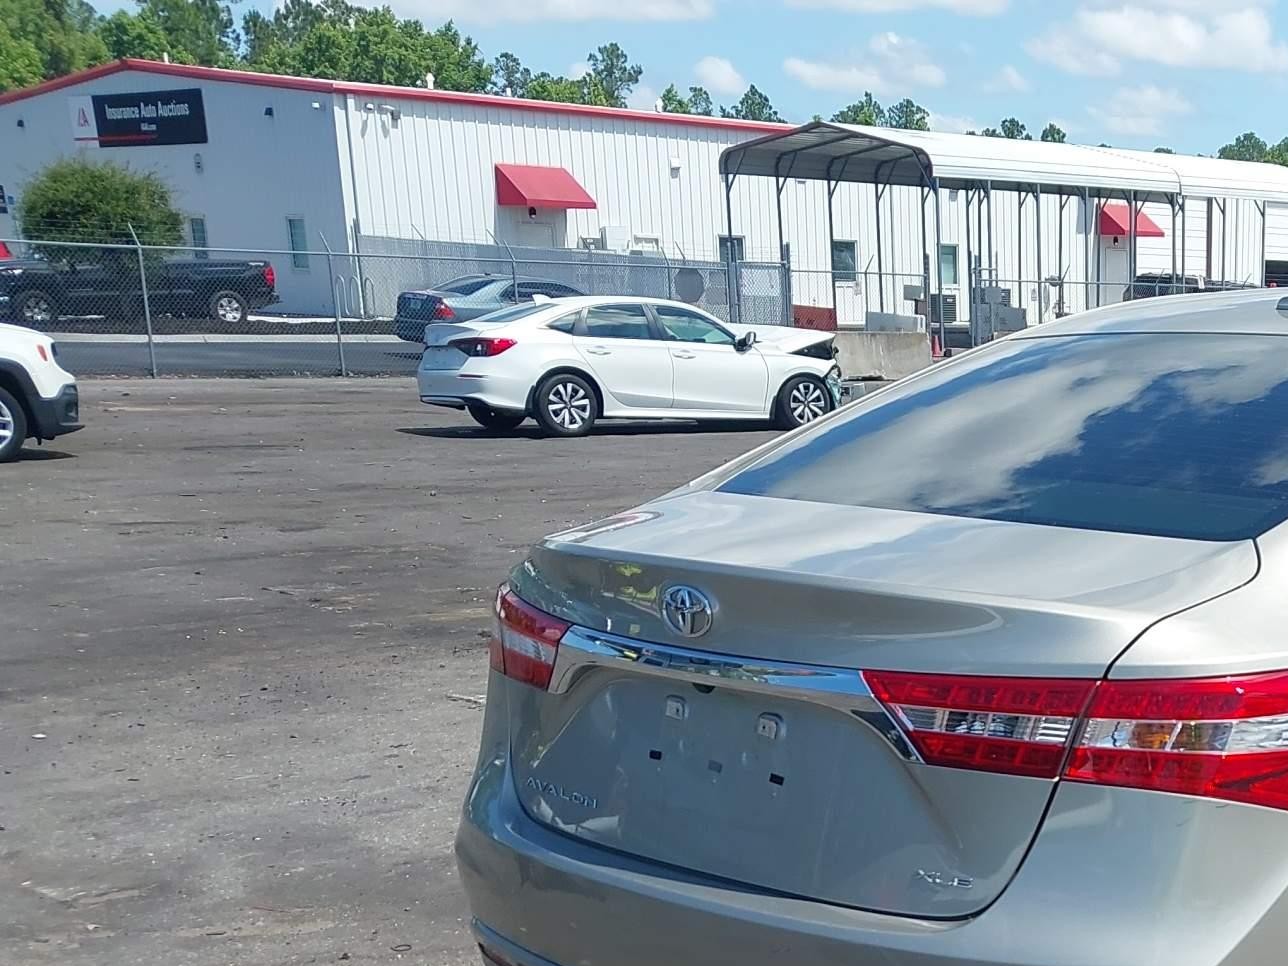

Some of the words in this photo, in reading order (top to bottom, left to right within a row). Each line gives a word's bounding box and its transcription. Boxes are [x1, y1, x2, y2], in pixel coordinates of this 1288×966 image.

[105, 104, 140, 120] Insurance
[140, 102, 157, 118] Auto
[158, 100, 189, 117] Auctions
[527, 776, 598, 809] AVALON
